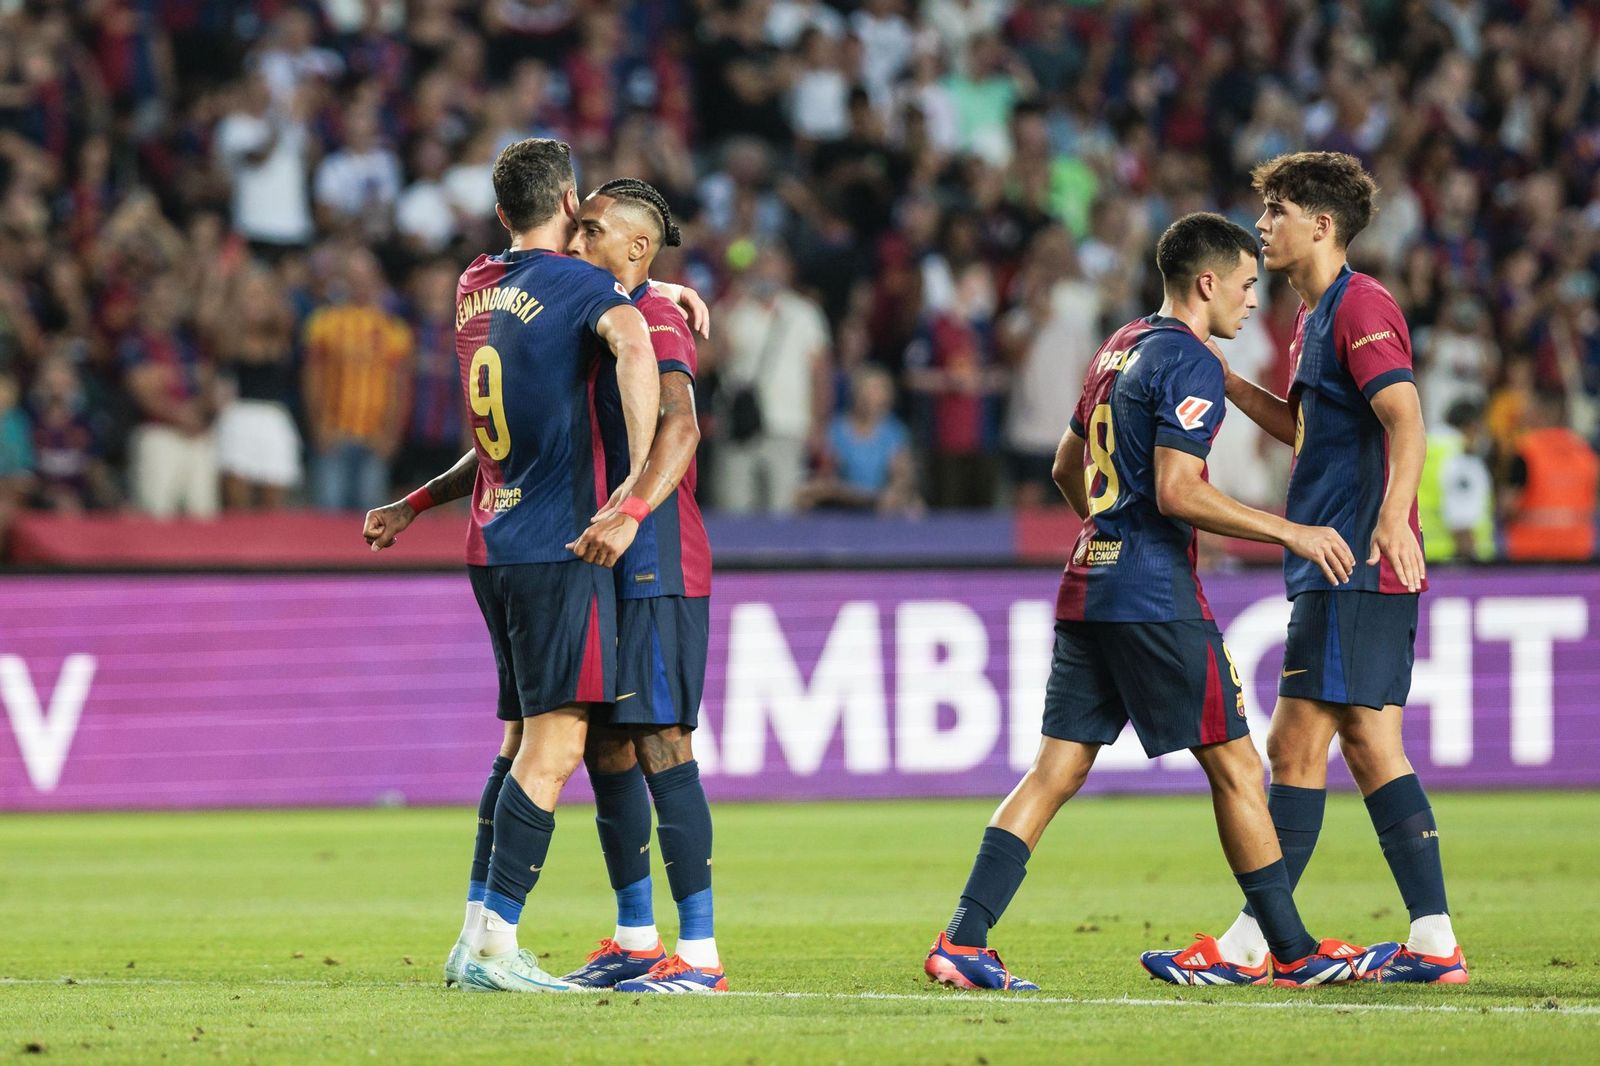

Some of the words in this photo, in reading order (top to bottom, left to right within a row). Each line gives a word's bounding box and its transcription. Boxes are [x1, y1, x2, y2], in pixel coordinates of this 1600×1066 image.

[456, 286, 544, 332] LEWANDOWSKI
[469, 345, 511, 461] 9
[1084, 403, 1120, 516] 8
